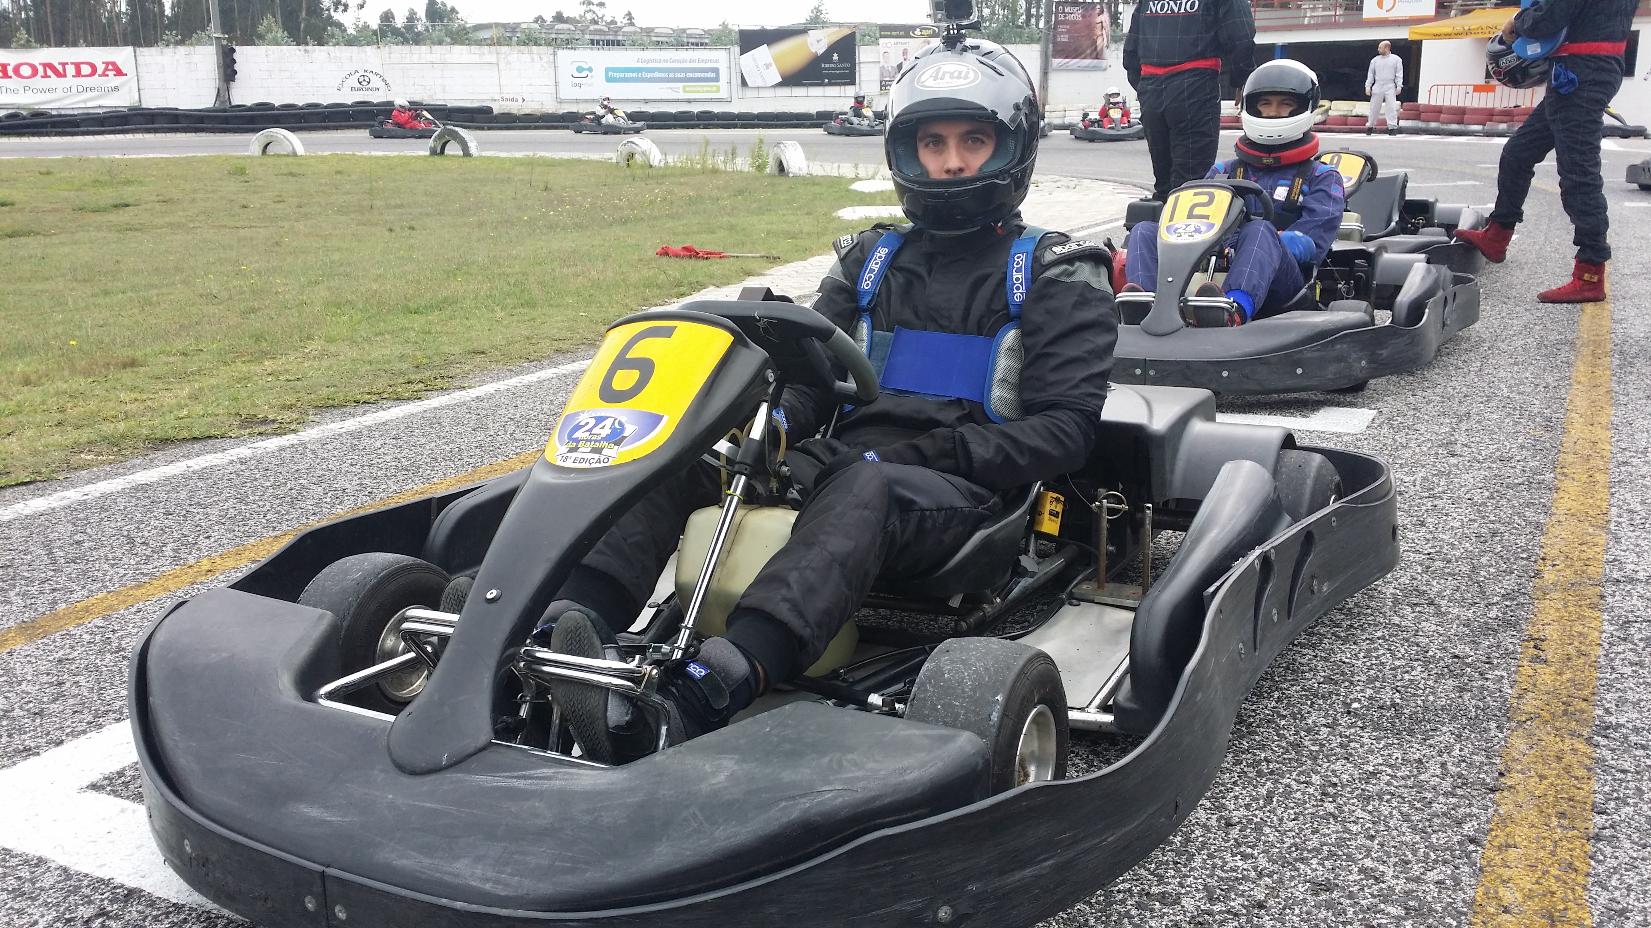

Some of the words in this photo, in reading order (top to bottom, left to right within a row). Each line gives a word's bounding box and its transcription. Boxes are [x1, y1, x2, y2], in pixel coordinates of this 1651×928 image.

[921, 66, 971, 84] Arai
[23, 85, 58, 95] Power
[62, 84, 73, 94] of
[76, 84, 120, 94] Dreams
[1168, 191, 1216, 222] 12
[861, 246, 888, 289] sparco
[1013, 253, 1026, 302] sparco
[598, 325, 678, 404] 6
[571, 417, 615, 439] 24
[578, 440, 615, 449] Batalha
[573, 455, 610, 465] EDIÇÃO
